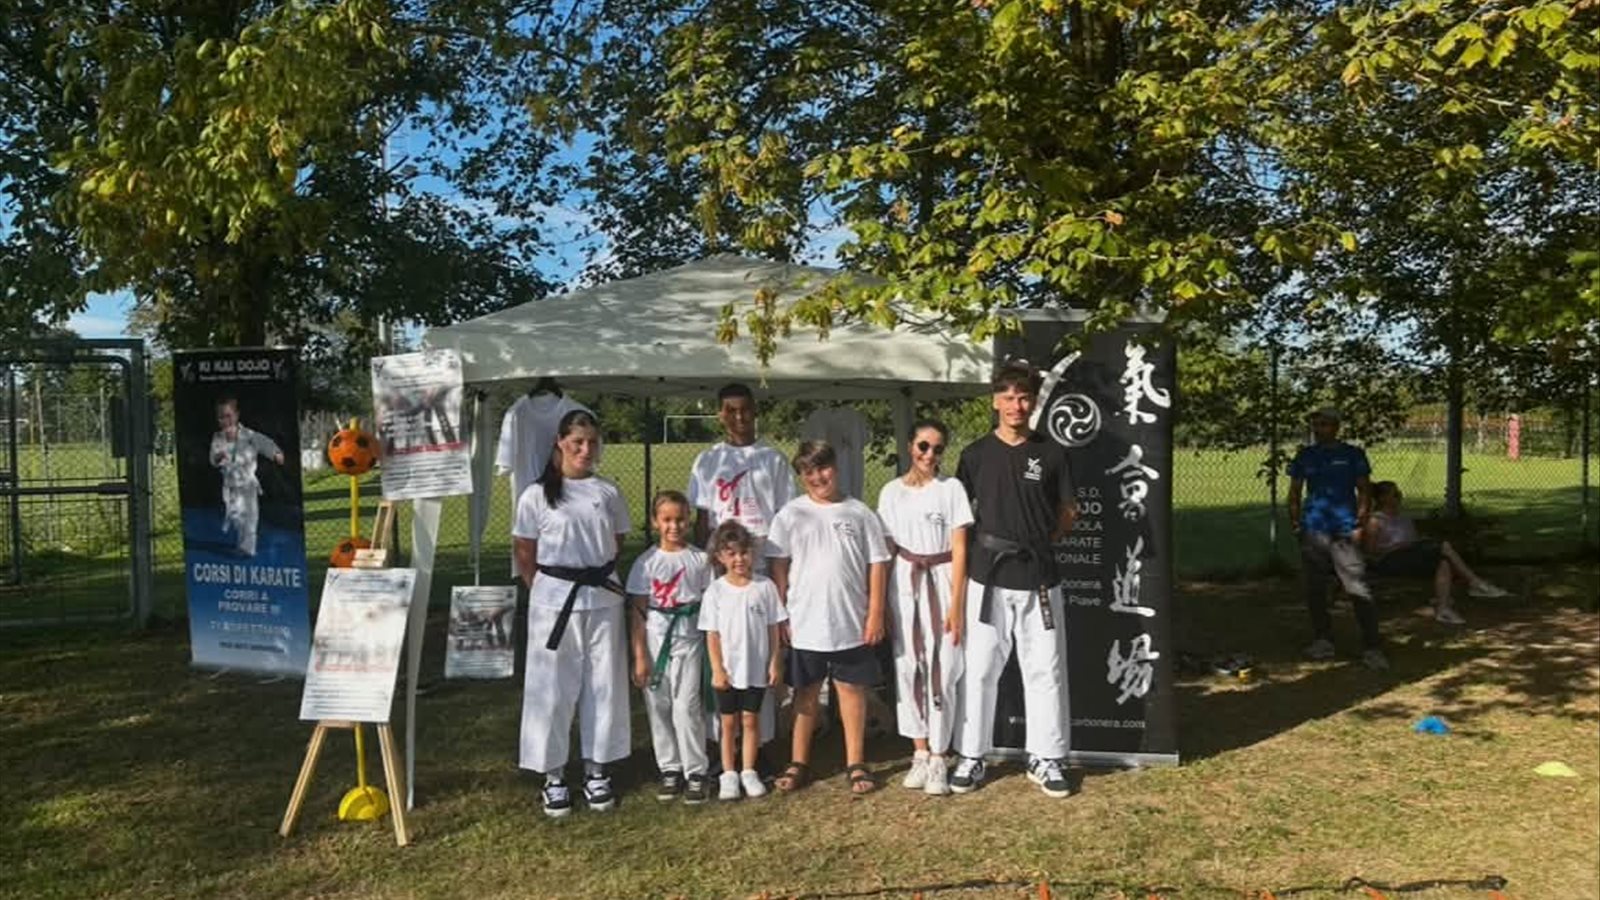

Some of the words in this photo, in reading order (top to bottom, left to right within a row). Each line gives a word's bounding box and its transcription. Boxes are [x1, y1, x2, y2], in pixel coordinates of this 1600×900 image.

[237, 359, 270, 372] DOJO
[193, 562, 231, 584] CORSI
[233, 564, 247, 585] DI
[250, 565, 302, 588] KARATE
[218, 600, 268, 614] PROVARE
